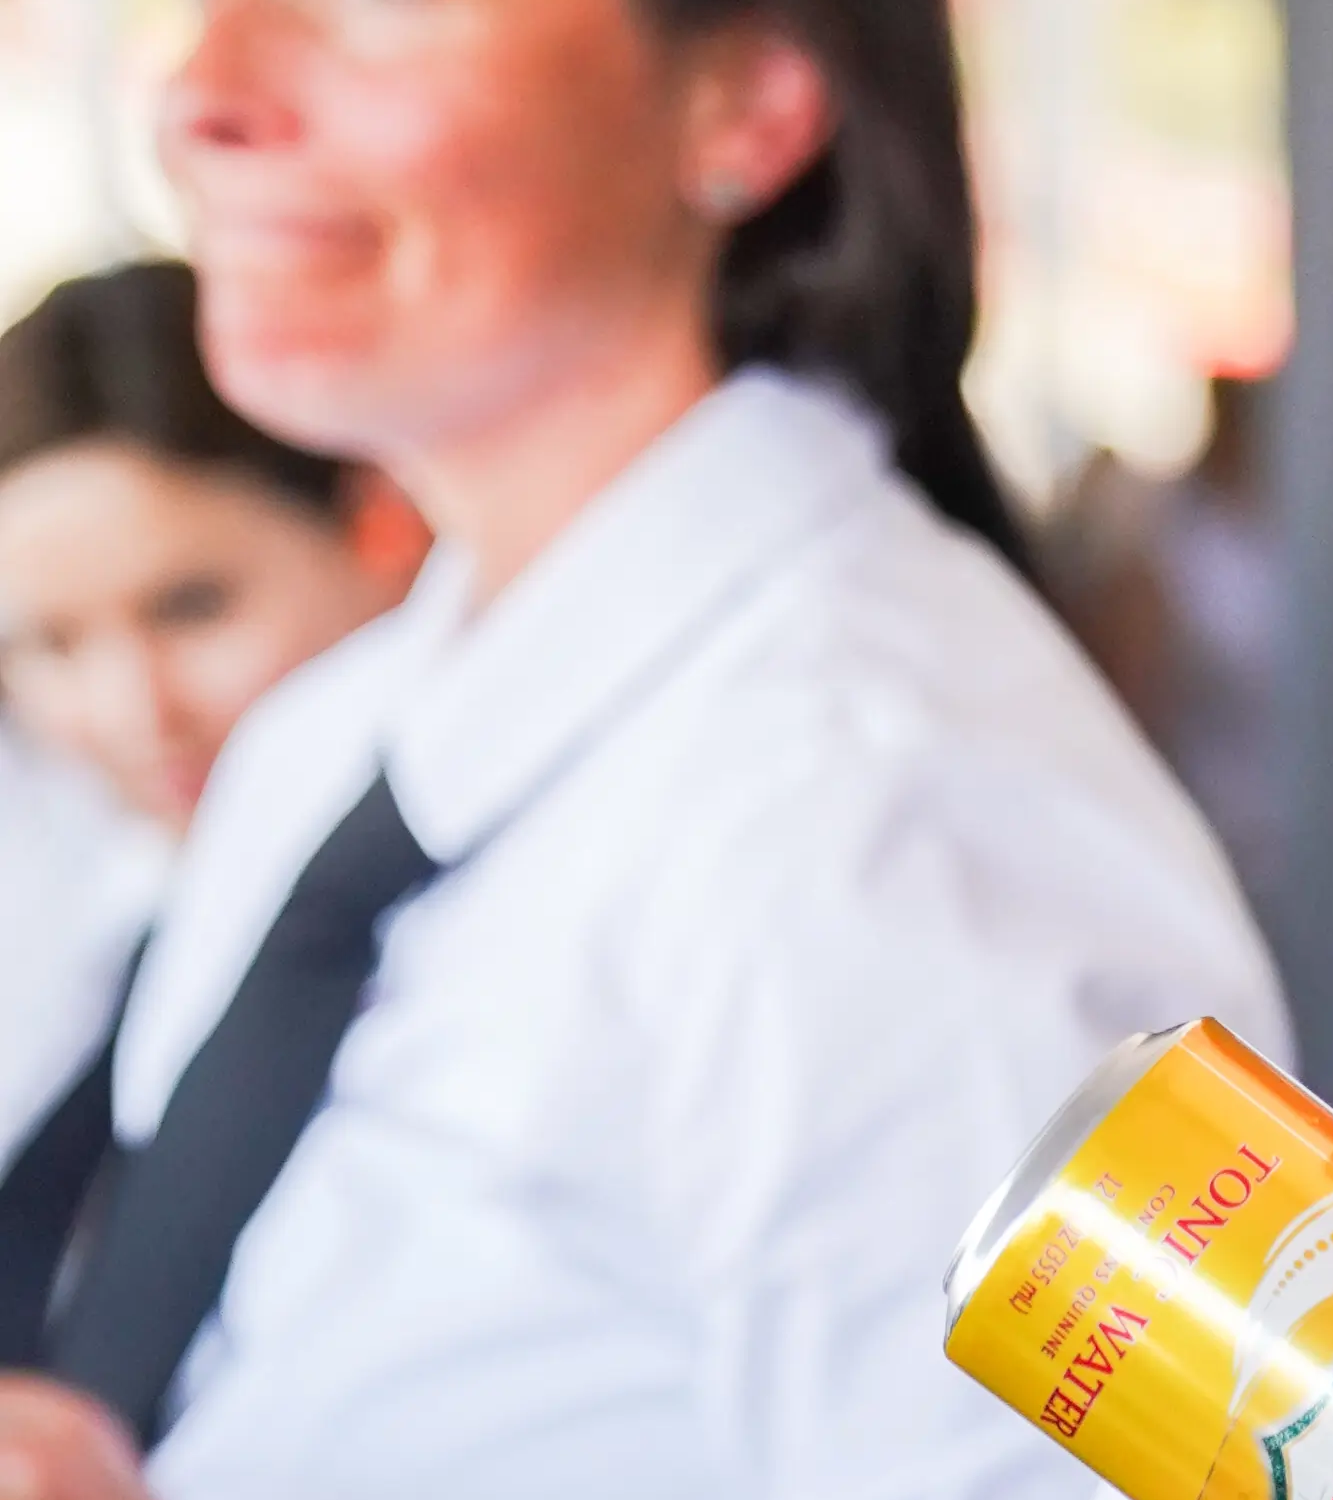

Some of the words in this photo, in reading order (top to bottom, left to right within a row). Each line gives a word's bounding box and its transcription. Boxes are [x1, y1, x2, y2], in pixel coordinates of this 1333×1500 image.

[1096, 1171, 1123, 1199] 12
[1031, 1243, 1068, 1287] (355
[1094, 1184, 1177, 1284] CONNS
[1041, 1285, 1097, 1360] QUININE
[1040, 1305, 1149, 1438] WATER
